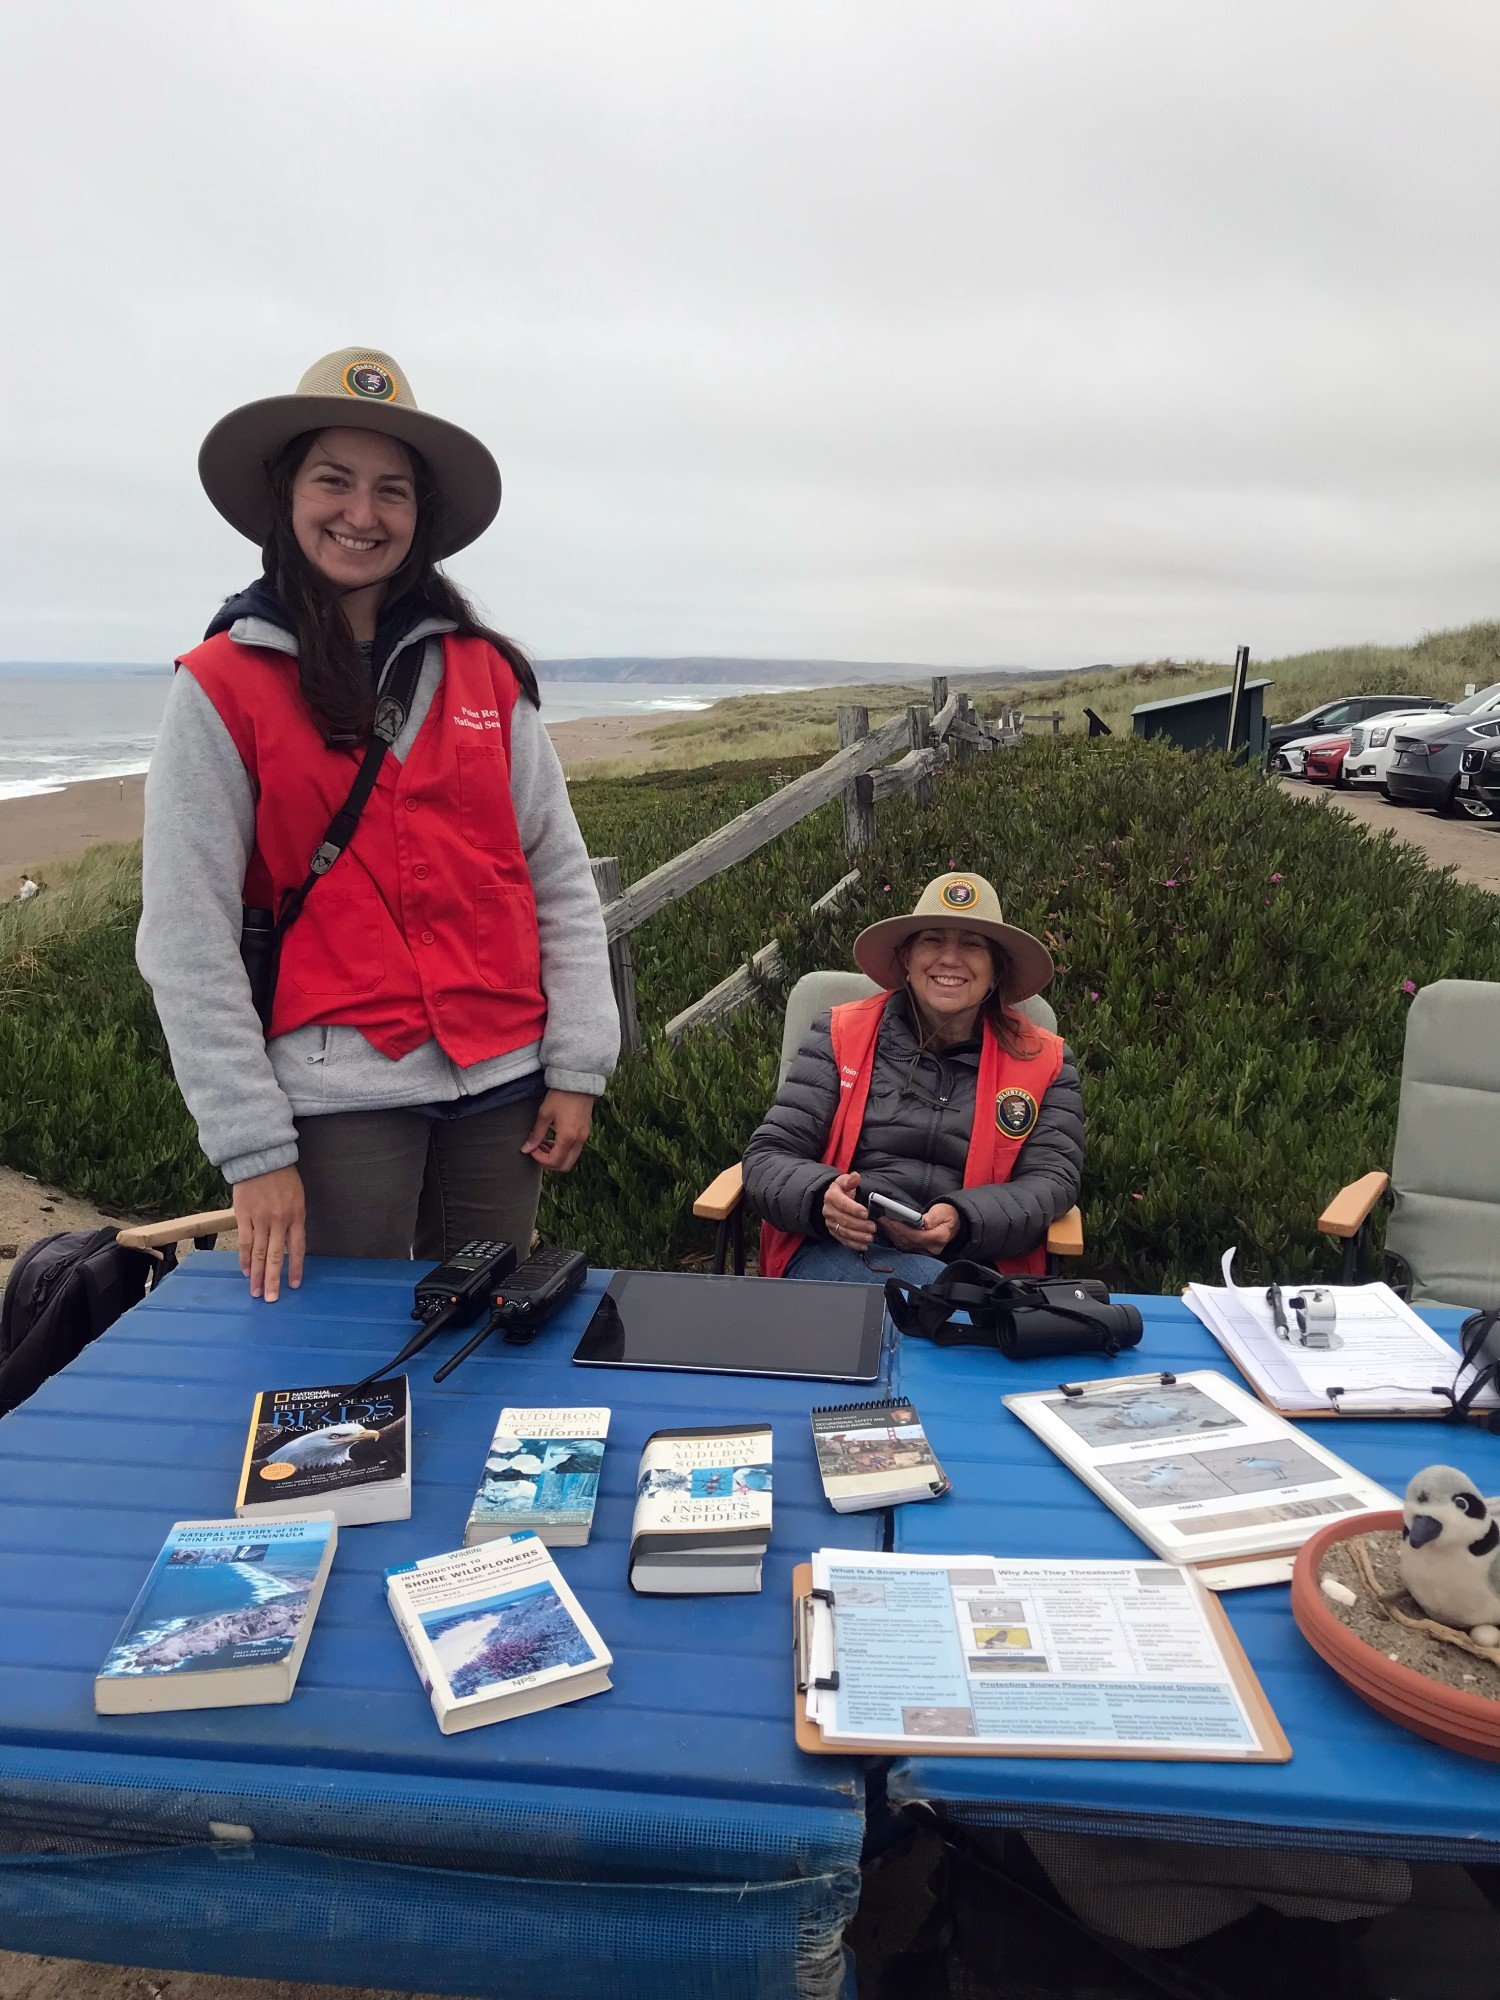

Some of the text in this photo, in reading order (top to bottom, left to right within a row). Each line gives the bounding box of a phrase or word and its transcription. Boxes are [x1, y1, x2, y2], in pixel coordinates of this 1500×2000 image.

[462, 706, 480, 718] Point
[453, 717, 483, 730] National
[996, 1090, 1030, 1103] VOLUNTEER
[291, 1393, 340, 1401] GEOGRAPHIC
[274, 1402, 312, 1412] FIELD
[314, 1398, 355, 1408] GDE
[507, 1412, 601, 1420] AUDUBON
[513, 1428, 600, 1437] California
[672, 1438, 758, 1450] NATIONAL
[673, 1448, 755, 1459] AUDUBON
[675, 1458, 752, 1468] SOCIETY
[672, 1502, 750, 1513] INSECTS
[660, 1510, 760, 1523] & SPIDERS
[249, 1532, 304, 1540] PENINSULA
[448, 1548, 482, 1560] Wildlife
[404, 1549, 538, 1588] SHORE WILDFLOWERS
[502, 1557, 543, 1571] Washington
[401, 1562, 466, 1581] INTRODUCTION
[512, 1675, 536, 1687] NPS
